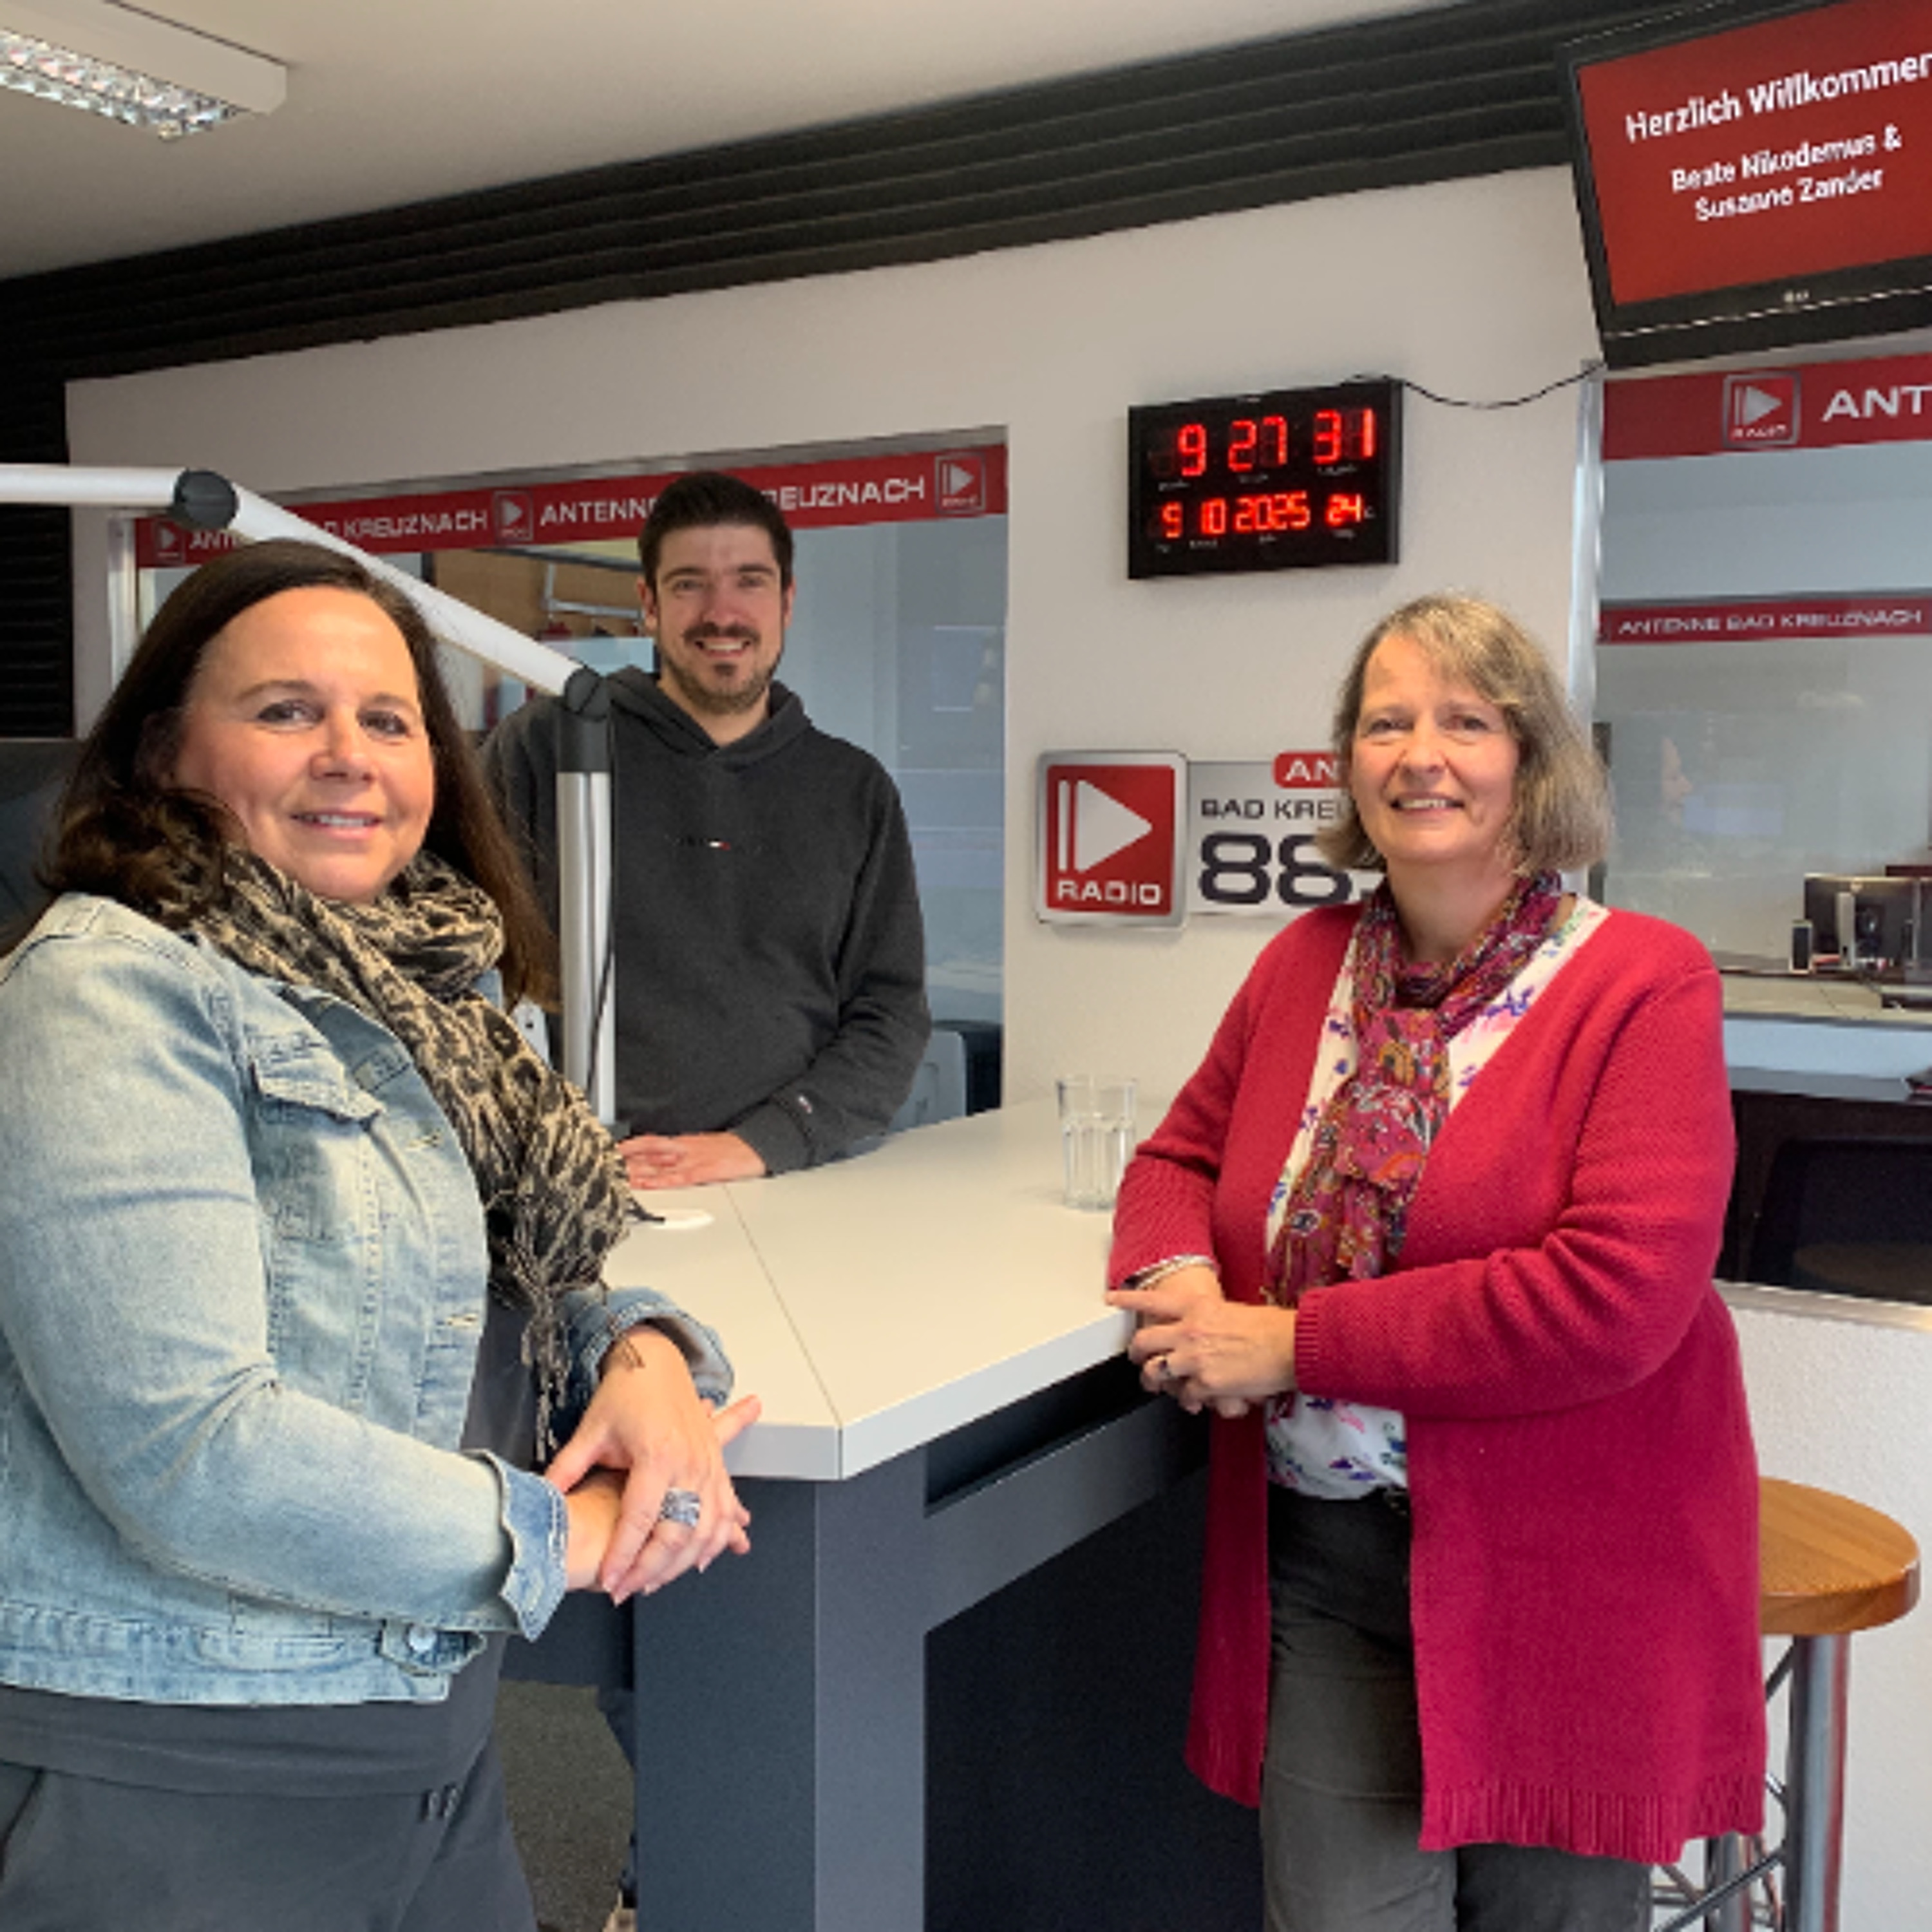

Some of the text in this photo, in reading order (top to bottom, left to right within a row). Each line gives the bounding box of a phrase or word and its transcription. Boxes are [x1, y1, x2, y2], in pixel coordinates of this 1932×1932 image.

[1625, 90, 1741, 142] Herzlich
[1671, 124, 1901, 192] Beate Nikodemus &
[1695, 168, 1883, 222] Susanne Zander
[1177, 407, 1374, 477] 9 27 31
[761, 475, 925, 511] EUZNACH
[1200, 497, 1226, 535] 10
[1235, 490, 1311, 533] 2025
[1325, 493, 1364, 527] 24
[1618, 618, 1719, 634] ANTENNE
[1727, 614, 1774, 630] BAD
[1284, 759, 1337, 781] AN
[1200, 799, 1264, 819] BAD
[1057, 880, 1161, 905] RADIO
